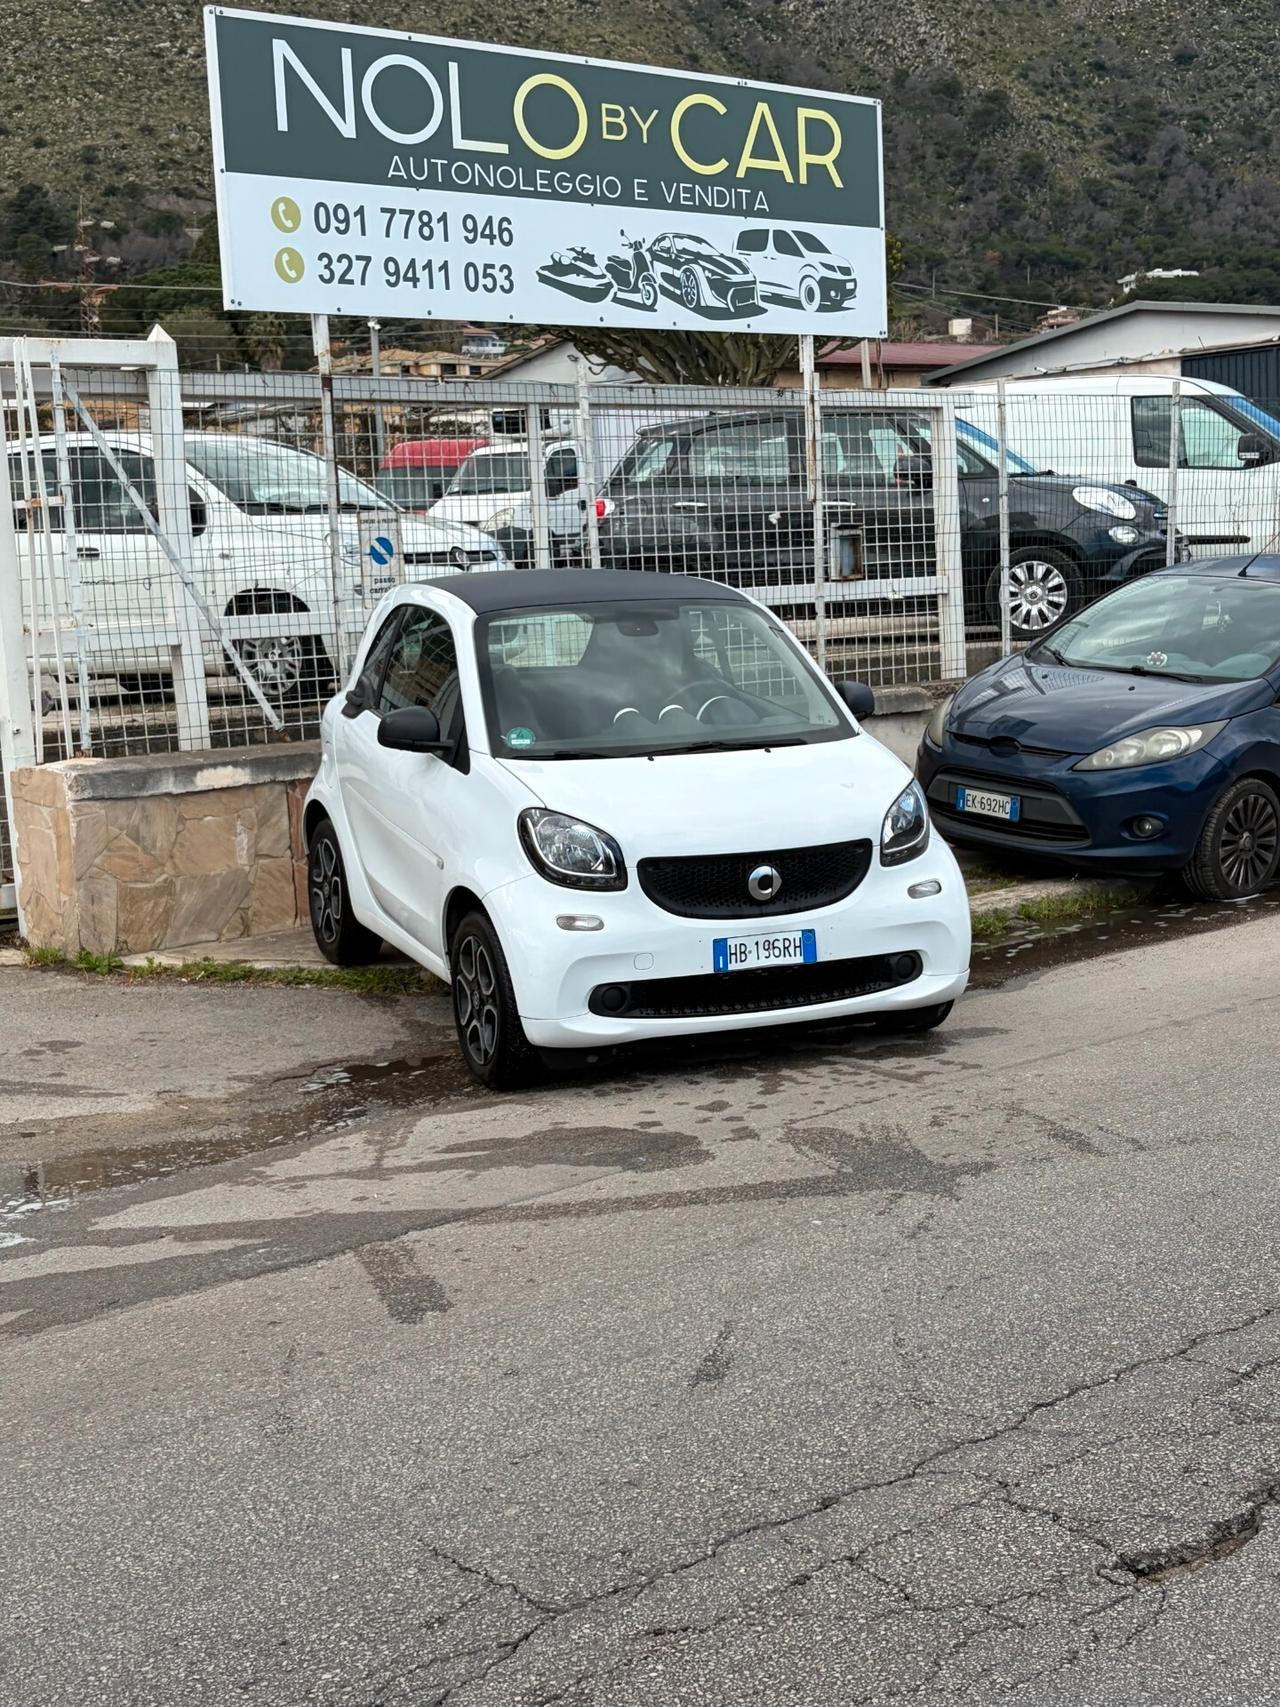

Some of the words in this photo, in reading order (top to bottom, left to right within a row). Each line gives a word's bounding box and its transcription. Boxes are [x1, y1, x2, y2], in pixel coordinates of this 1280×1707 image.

[272, 38, 588, 160] NOLO
[600, 102, 659, 143] BY
[670, 93, 844, 188] CAR
[387, 155, 621, 198] AUTONOLEGGIO
[633, 179, 648, 201] E
[660, 181, 769, 212] VENDITA
[313, 202, 366, 237] 091
[380, 207, 449, 243] 7781
[462, 214, 514, 247] 946
[317, 252, 372, 286] 327
[383, 256, 450, 290] 9411
[463, 262, 515, 294] 053
